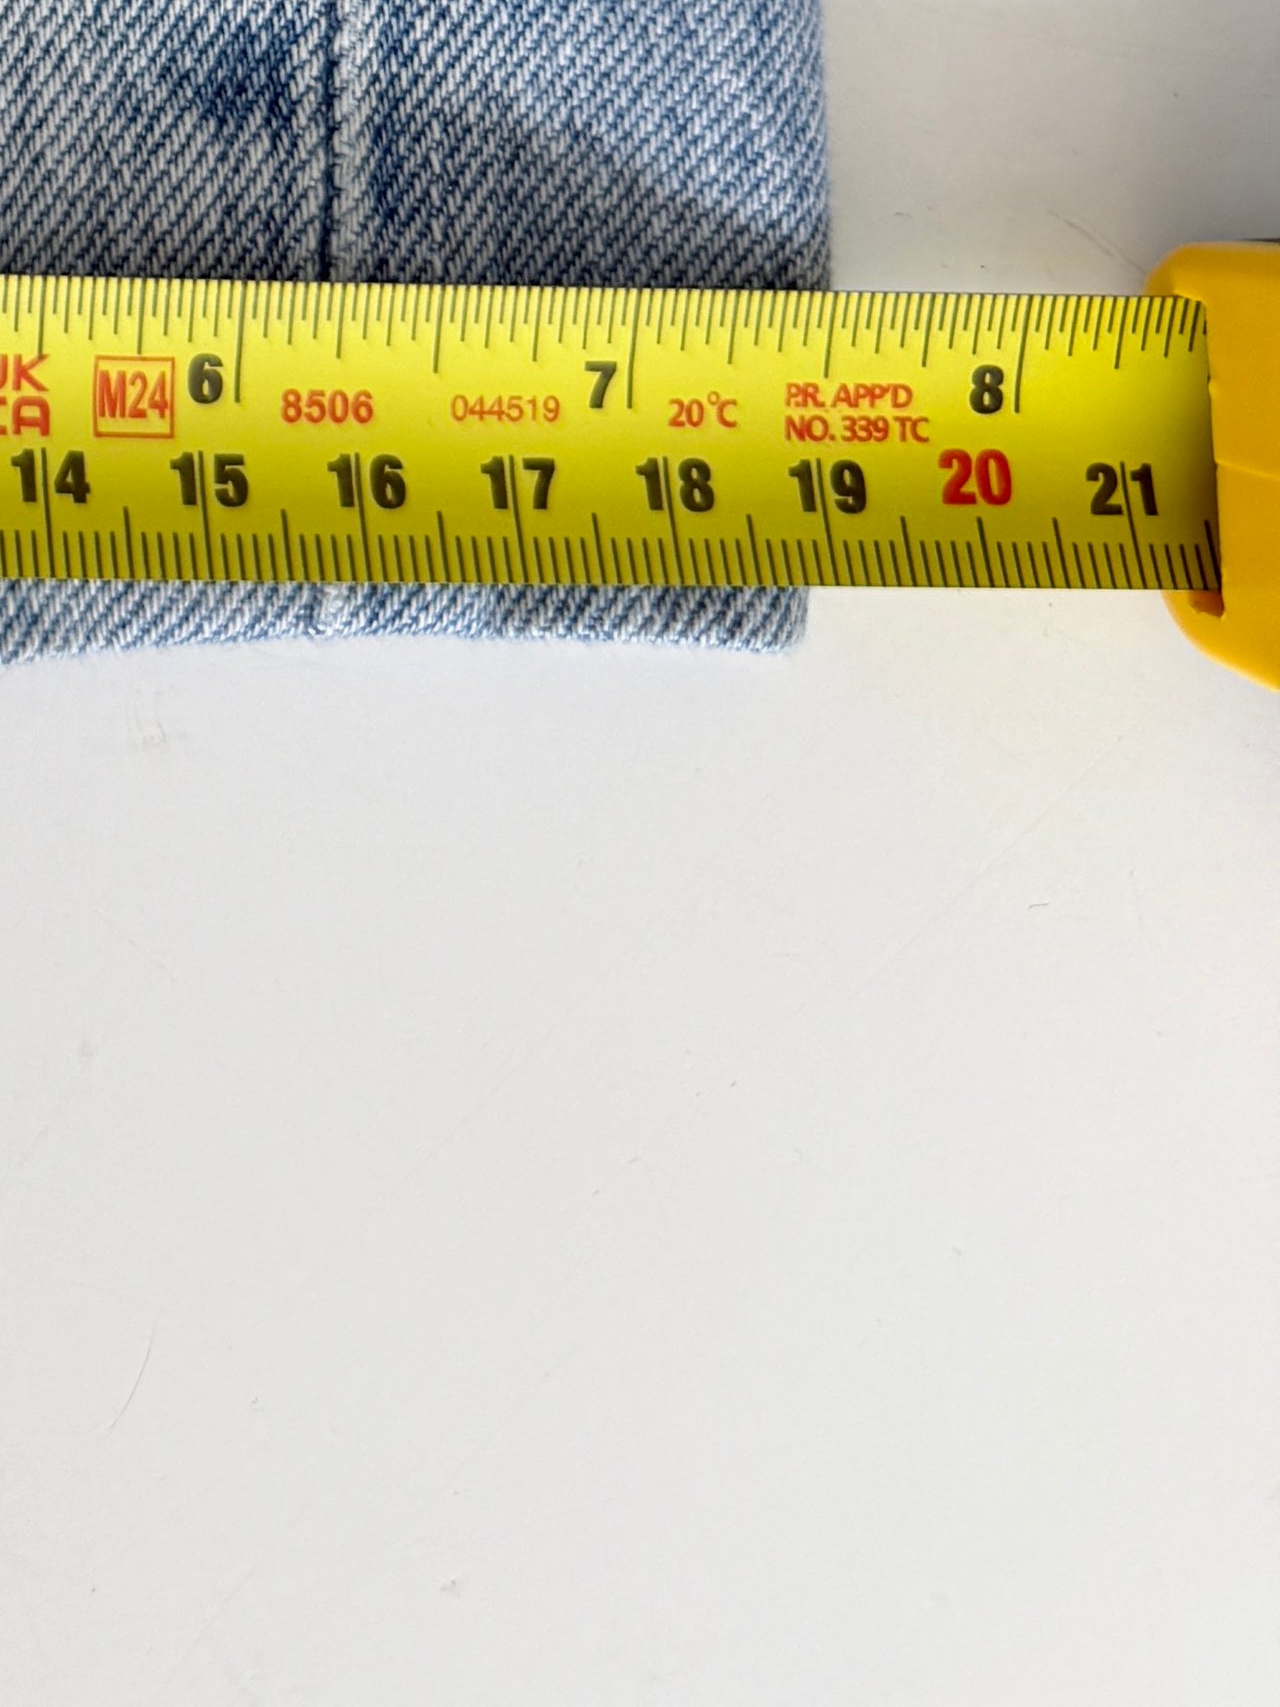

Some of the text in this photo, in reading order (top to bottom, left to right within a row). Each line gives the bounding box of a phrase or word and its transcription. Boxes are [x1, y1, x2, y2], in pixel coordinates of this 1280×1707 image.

[98, 370, 169, 420] M24
[188, 353, 224, 406] 6
[281, 389, 374, 425] 8506
[584, 360, 618, 411] 7
[969, 365, 1005, 415] 8
[451, 395, 561, 424] 044519
[784, 415, 930, 443] NO. 339 TC
[10, 448, 92, 504] 14
[169, 450, 249, 509] 15
[327, 453, 407, 510] 16
[480, 455, 557, 512] 17
[636, 457, 715, 514] 18
[788, 458, 868, 515] 19
[938, 448, 1013, 507] 20
[1085, 462, 1159, 517] 21
